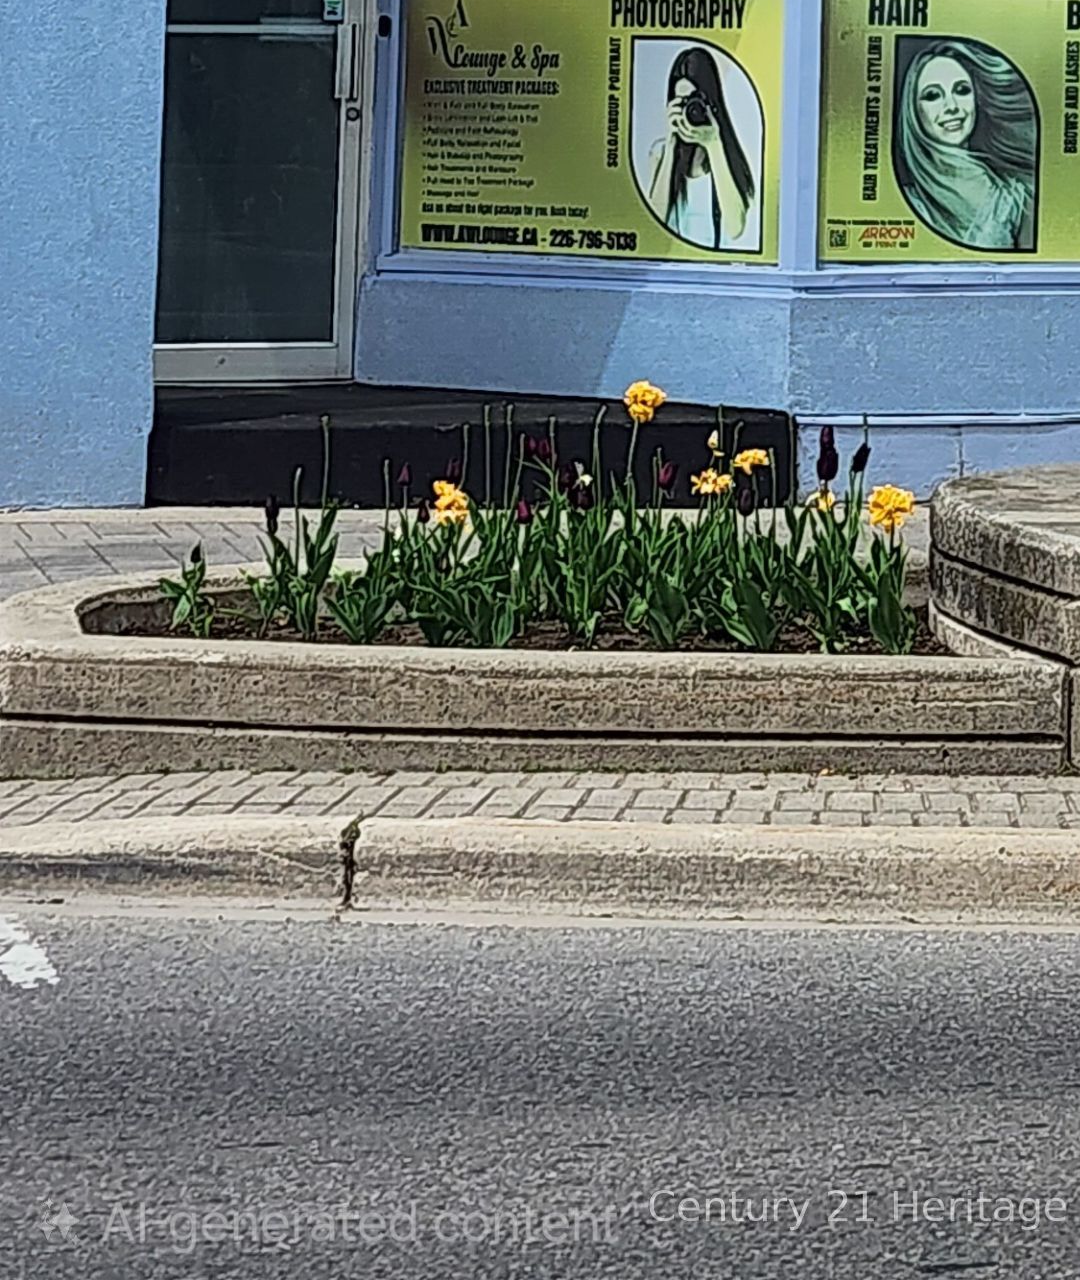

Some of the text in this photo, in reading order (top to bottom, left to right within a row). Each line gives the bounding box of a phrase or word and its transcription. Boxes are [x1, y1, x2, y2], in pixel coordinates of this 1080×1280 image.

[453, 44, 560, 77] Lounge & Spa
[867, 35, 882, 82] STYLING
[467, 80, 513, 95] TREATMENT
[607, 37, 621, 168] SOLO/GROUP PORTRAIT
[1063, 40, 1080, 154] BROWS AND LASHES
[863, 96, 880, 170] TREATMENTS
[862, 174, 877, 201] HAIR
[858, 227, 915, 241] ARROW
